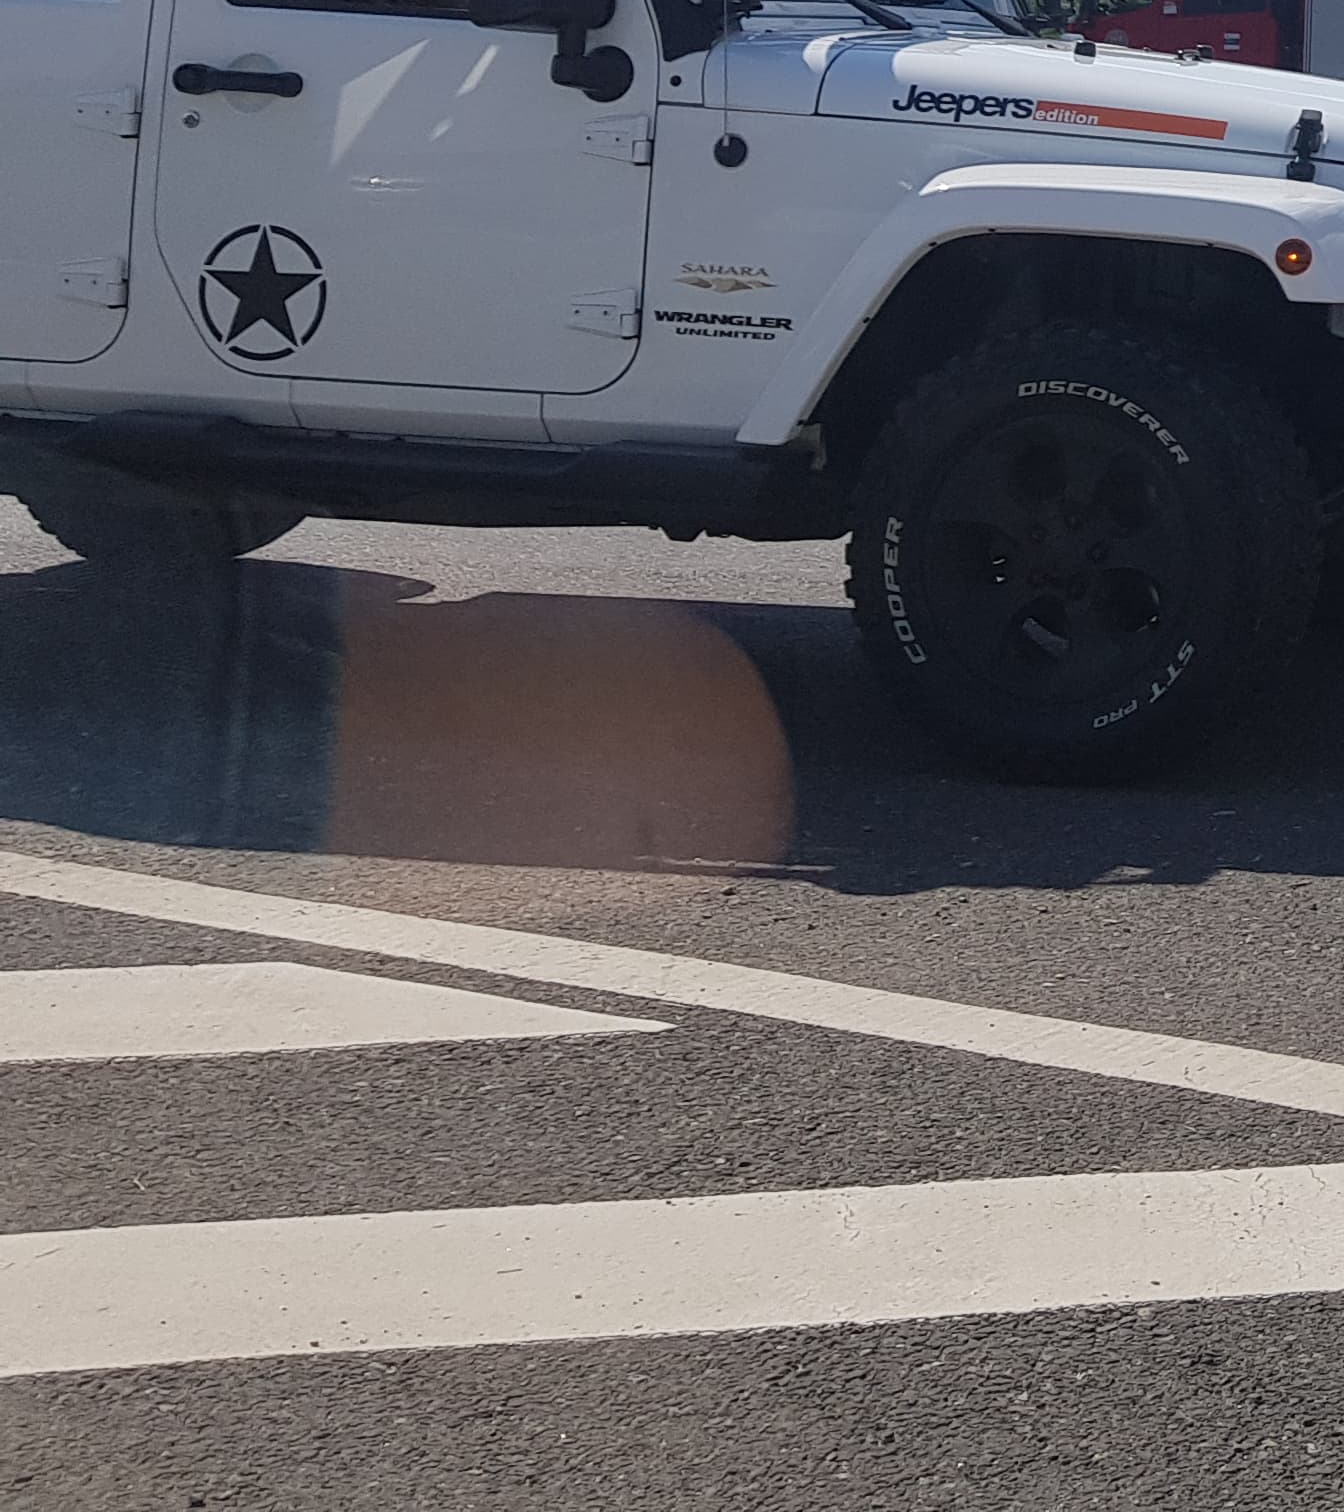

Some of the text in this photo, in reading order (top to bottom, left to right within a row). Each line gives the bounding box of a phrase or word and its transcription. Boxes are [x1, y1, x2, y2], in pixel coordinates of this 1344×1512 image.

[892, 84, 1099, 126] Jeepers edition
[681, 263, 769, 277] SAHARA
[654, 310, 793, 331] WRANGLER
[675, 327, 776, 341] UNLIMITED
[1017, 380, 1190, 465] DISCOVERER
[883, 516, 927, 664] COOPER
[1093, 639, 1194, 728] STT PRO
